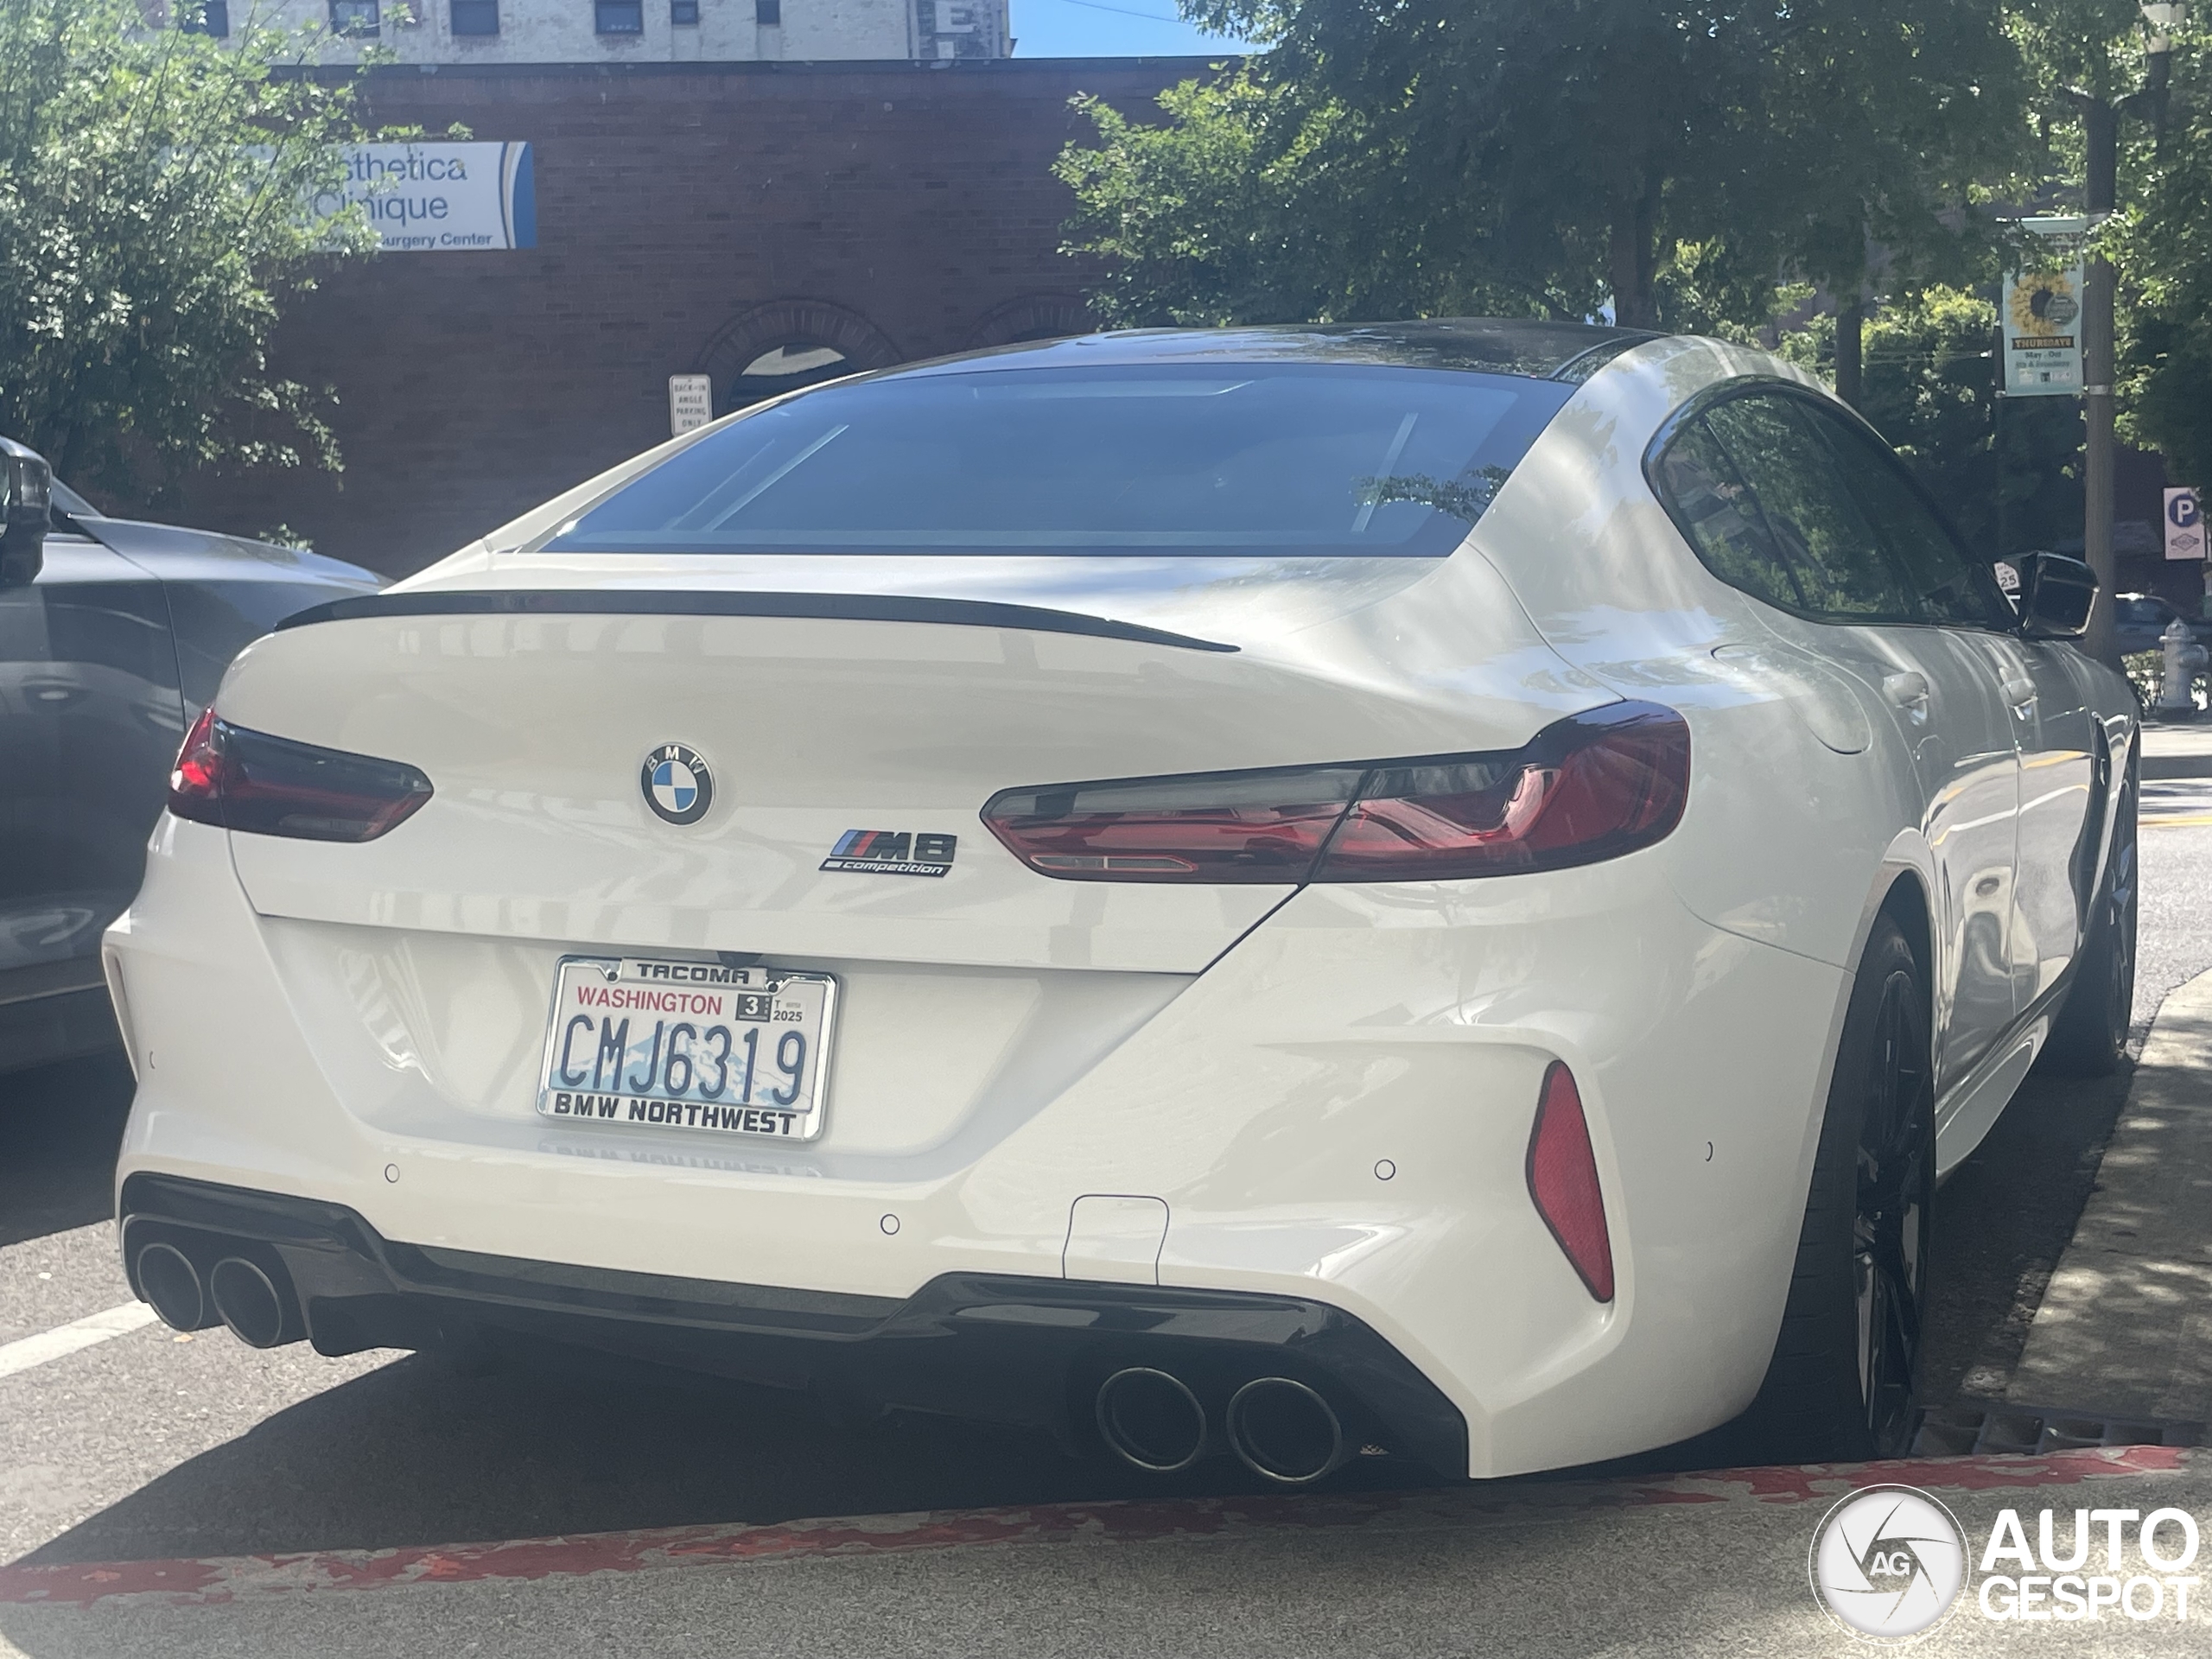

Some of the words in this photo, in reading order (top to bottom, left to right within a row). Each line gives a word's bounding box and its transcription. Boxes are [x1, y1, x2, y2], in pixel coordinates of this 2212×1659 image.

[338, 151, 467, 181] sthetica
[381, 234, 436, 249] urgery
[441, 232, 493, 245] Center
[677, 407, 706, 416] PARKING
[682, 419, 702, 428] ONLY
[2177, 499, 2194, 524] P
[2000, 574, 2017, 588] 25
[645, 745, 705, 774] BMW
[873, 830, 957, 862] M8
[842, 861, 944, 875] competition
[637, 963, 750, 985] TACOMA
[577, 986, 722, 1016] WASHINGTON
[745, 995, 759, 1015] 3
[773, 1010, 803, 1022] 2025
[560, 1014, 807, 1106] CMJ6319
[554, 1093, 620, 1119] BMW
[628, 1099, 798, 1135] NORTHWEST
